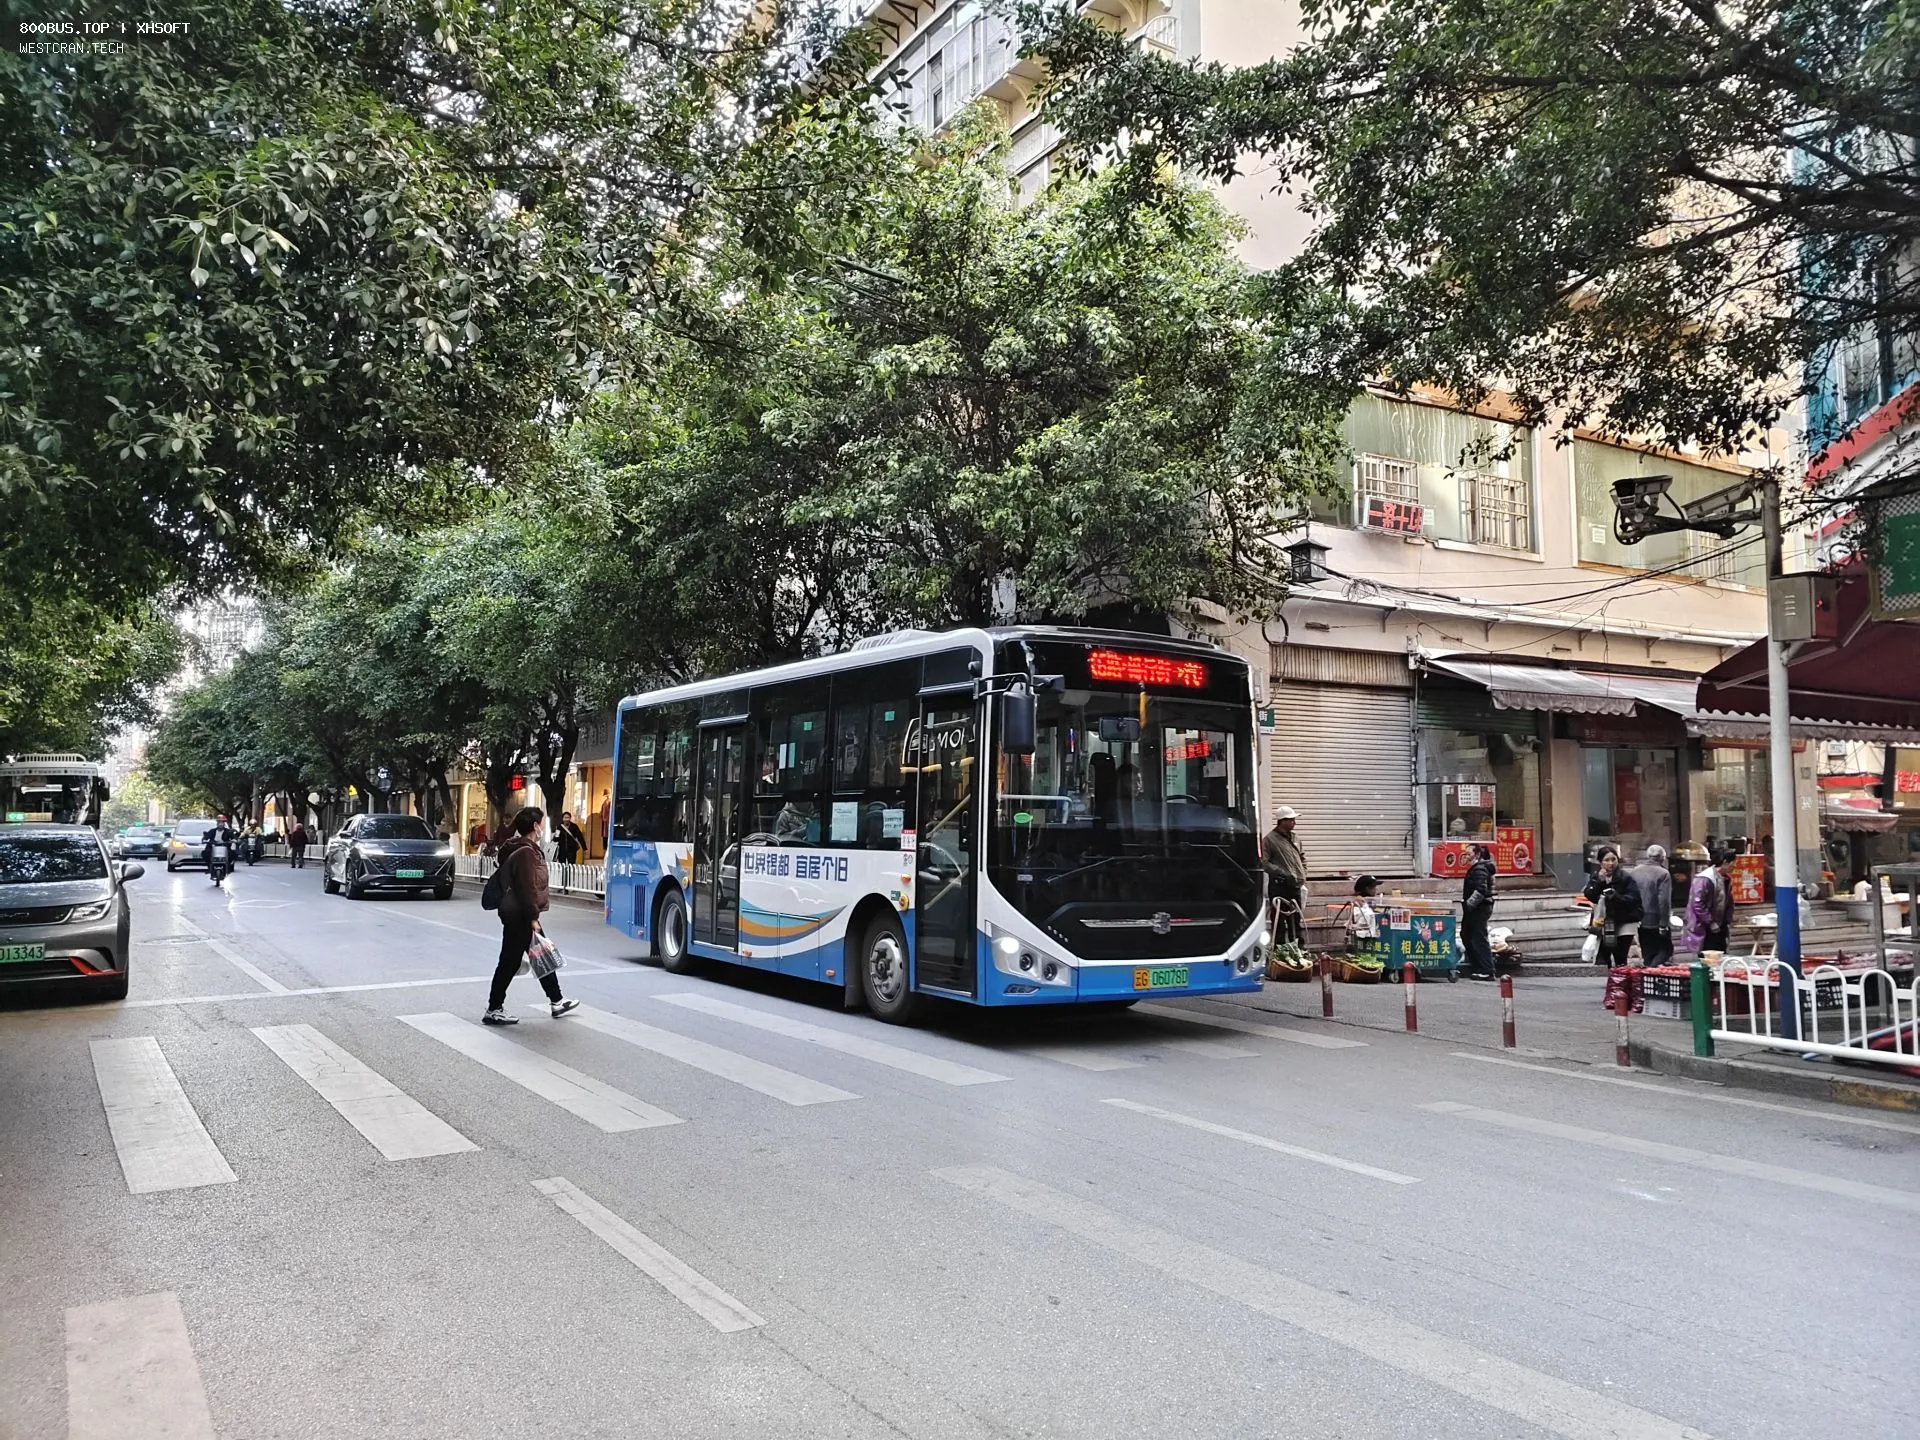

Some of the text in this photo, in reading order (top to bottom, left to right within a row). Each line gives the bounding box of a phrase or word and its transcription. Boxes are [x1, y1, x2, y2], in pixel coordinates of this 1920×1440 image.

[744, 852, 848, 882] 世界锡都 宜居个旧
